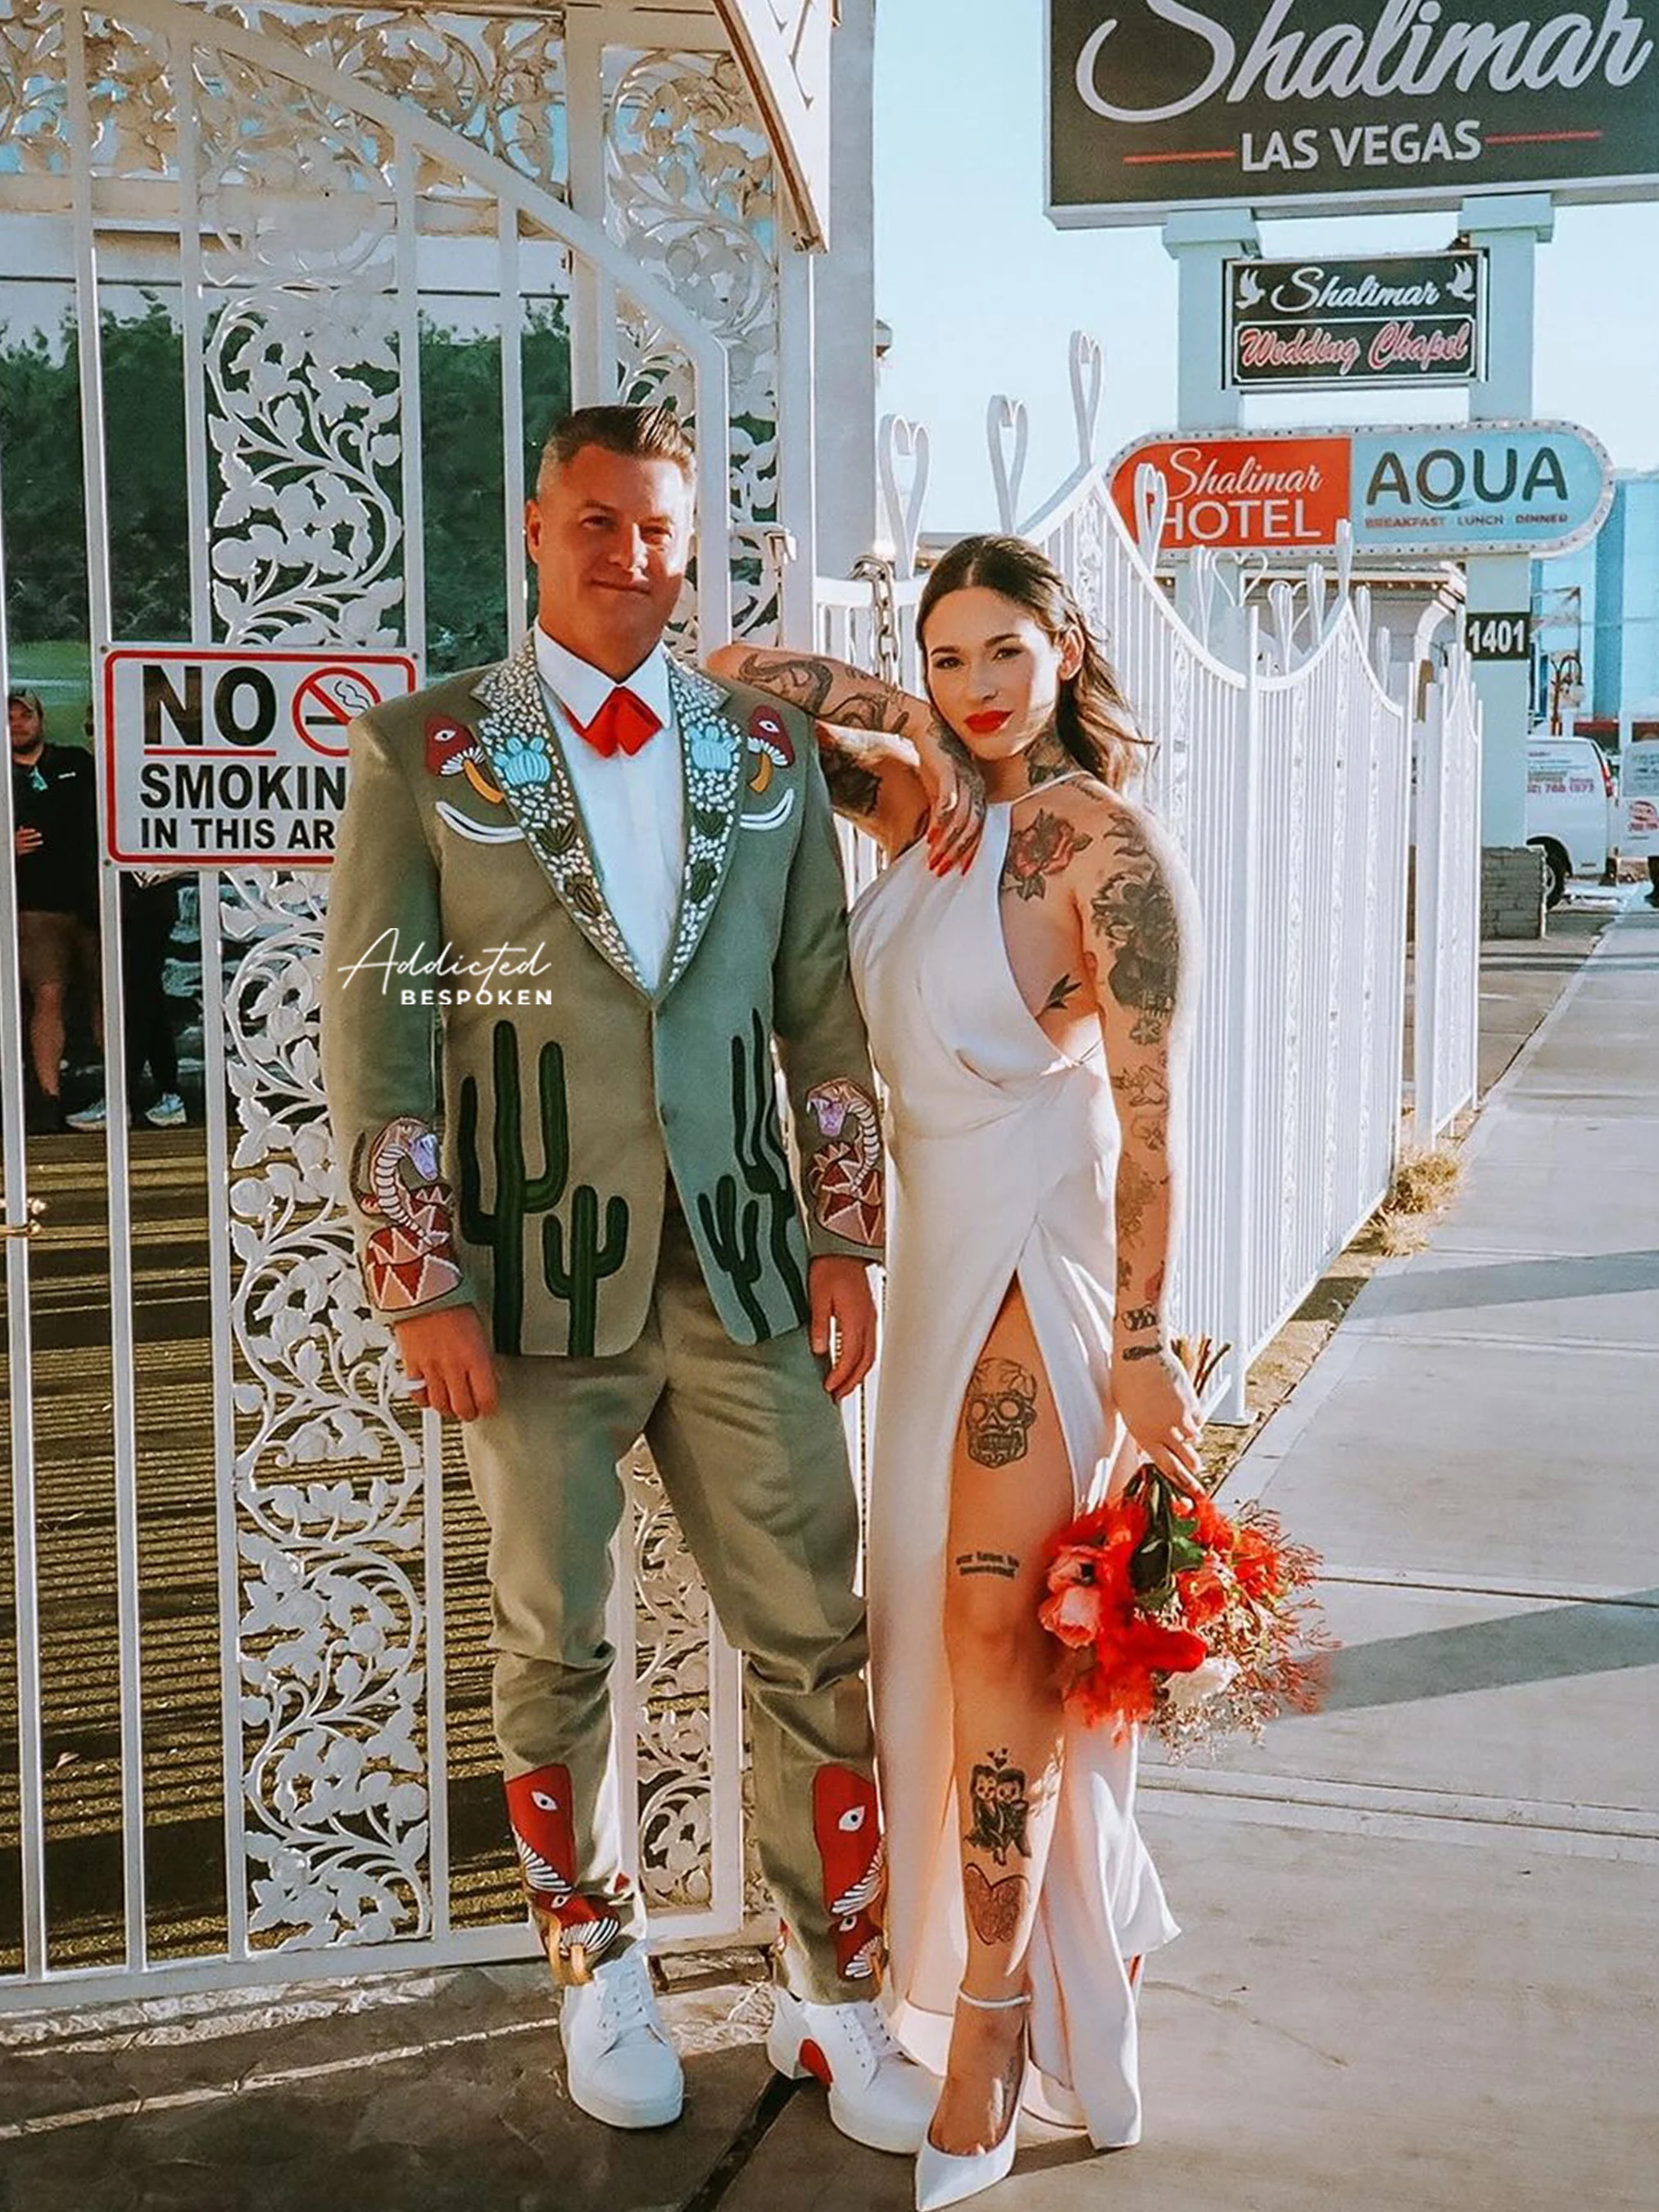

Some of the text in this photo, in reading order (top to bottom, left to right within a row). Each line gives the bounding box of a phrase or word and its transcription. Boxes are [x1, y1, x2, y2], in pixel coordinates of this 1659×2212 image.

[1076, 0, 1653, 122] Shalimar
[1242, 120, 1482, 171] LAS VEGAS
[1271, 266, 1440, 312] Shalimar
[1240, 320, 1471, 375] Wedding Chapel
[1167, 446, 1323, 501] Shalimar
[1457, 514, 1504, 527] LUNCH
[1515, 514, 1568, 524] DINNER
[1469, 620, 1525, 653] 1401
[143, 664, 277, 746] NO
[140, 763, 347, 811] SMOKIN
[141, 818, 336, 850] IN THIS AR
